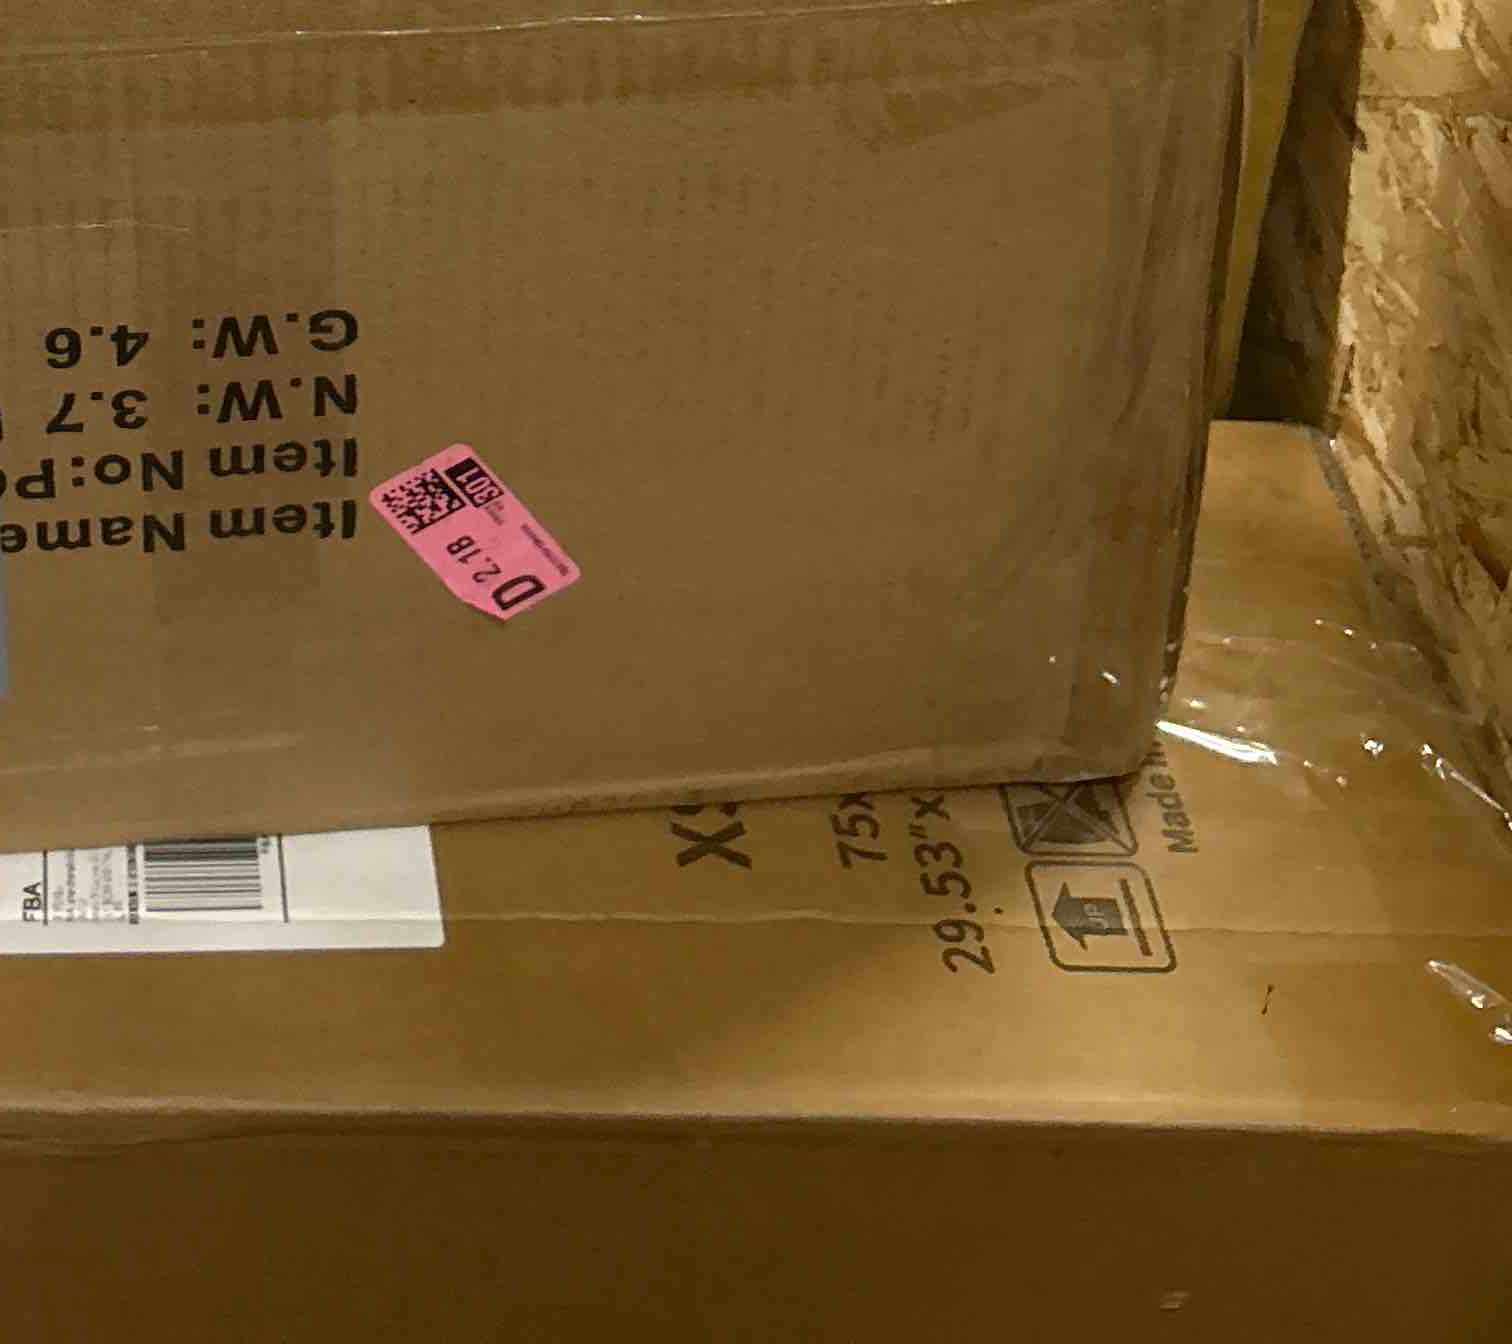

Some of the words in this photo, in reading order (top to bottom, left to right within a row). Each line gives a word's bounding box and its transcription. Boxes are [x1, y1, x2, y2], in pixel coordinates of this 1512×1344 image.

[44, 324, 150, 369] 4.6
[191, 309, 359, 359] G.W:
[45, 389, 149, 435] 3.7
[196, 373, 358, 424] N.W:
[208, 437, 358, 479] Item
[0, 512, 186, 554] Name
[208, 498, 358, 540] Item
[21, 880, 42, 923] FBA
